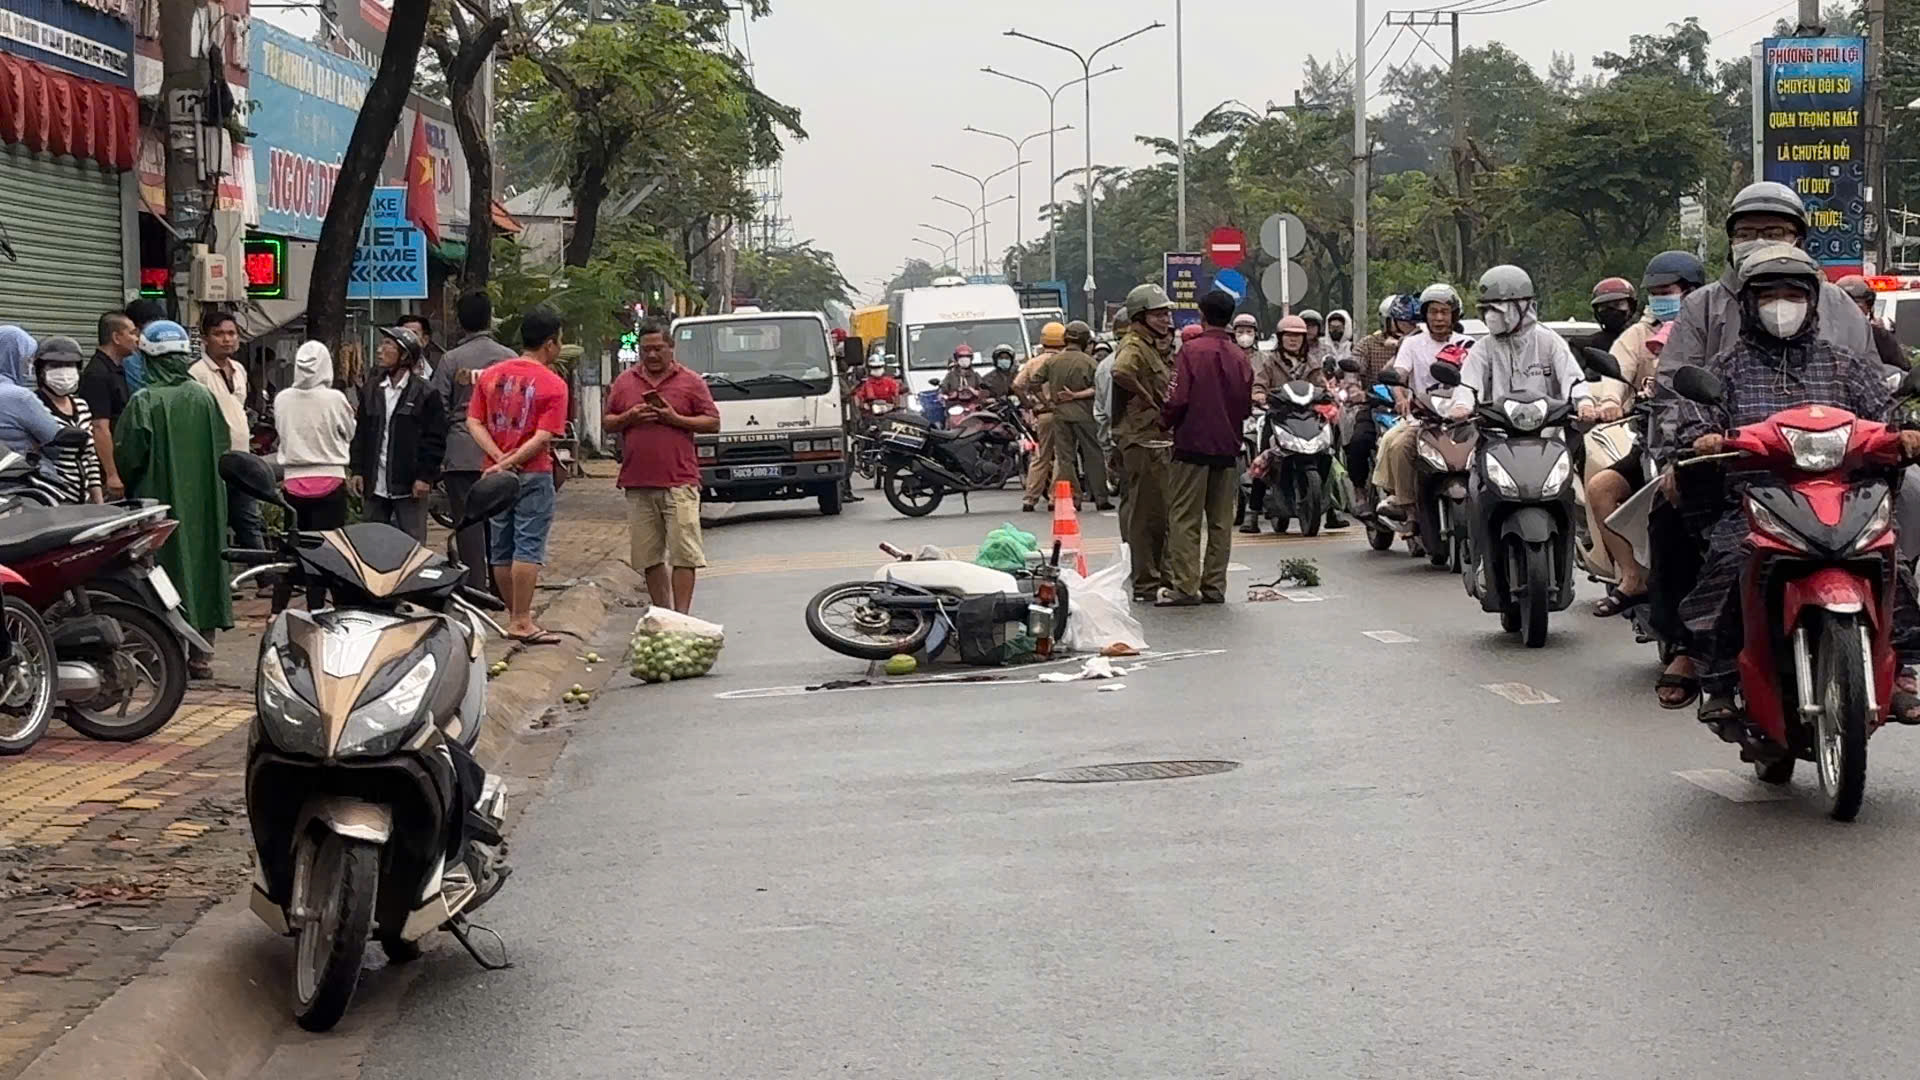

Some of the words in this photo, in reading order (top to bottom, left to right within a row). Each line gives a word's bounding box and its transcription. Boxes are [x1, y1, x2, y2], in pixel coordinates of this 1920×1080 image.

[1768, 111, 1796, 129] QUAN
[1798, 110, 1831, 131] TRỌNG
[1832, 106, 1859, 127] NHẤT
[1792, 138, 1831, 161] CHUYỂN
[1811, 177, 1830, 193] DUY
[718, 433, 789, 443] MITSUBISHI
